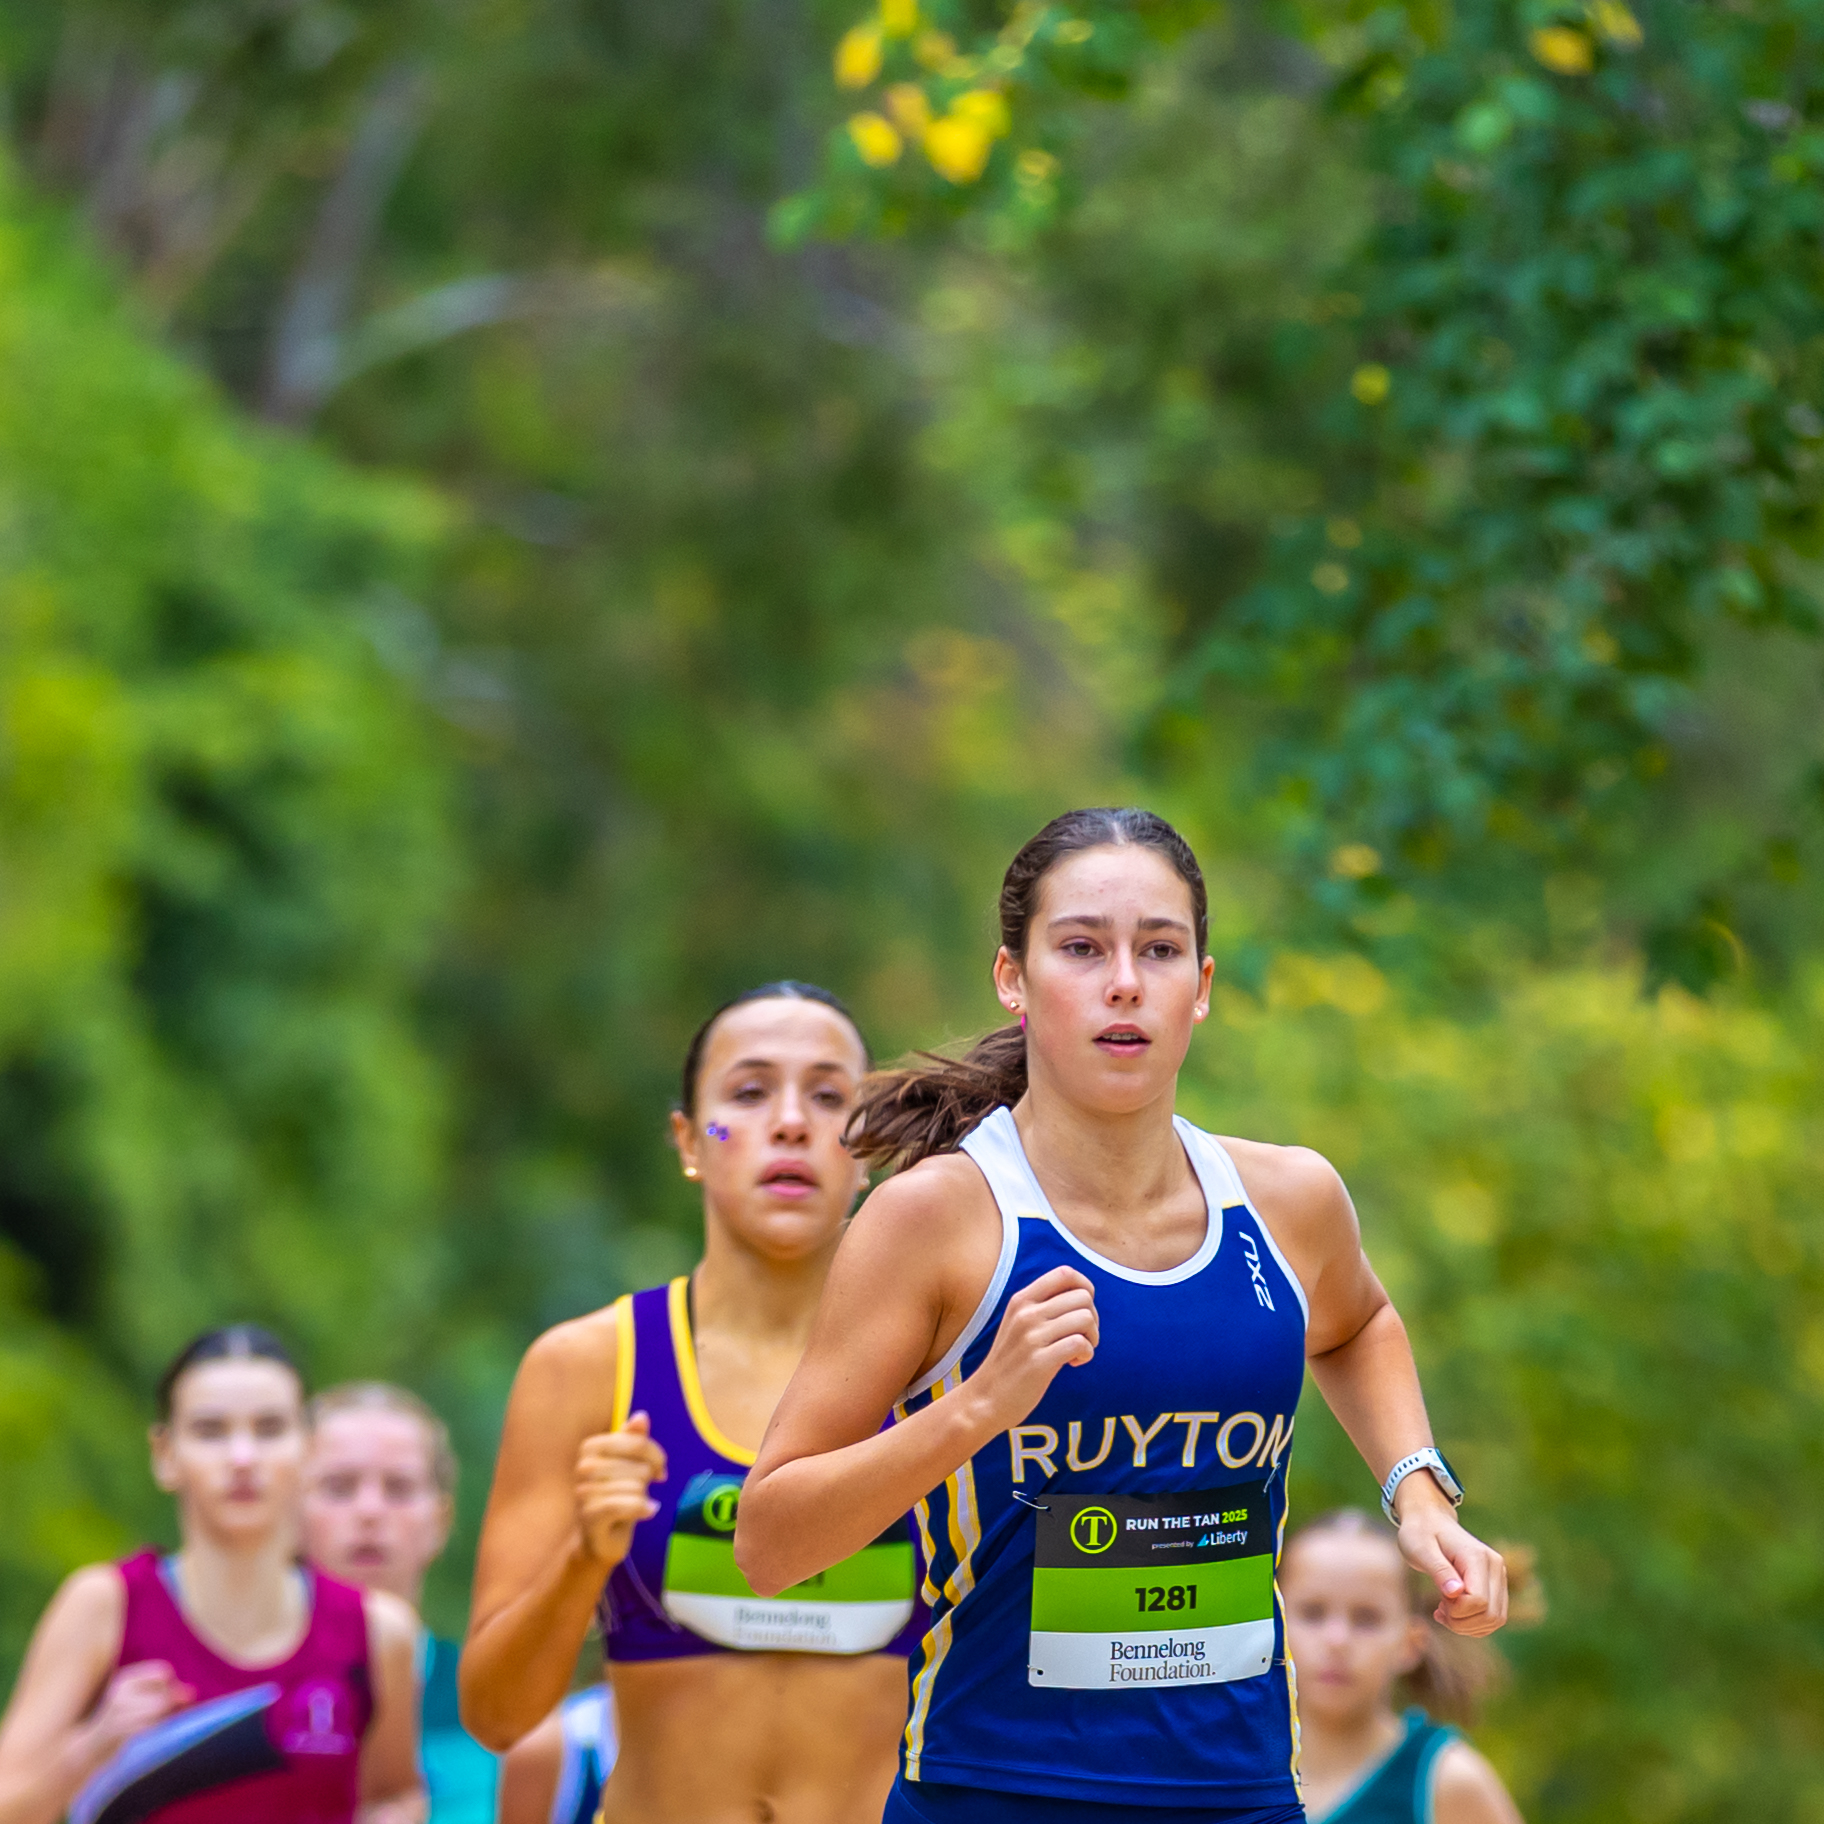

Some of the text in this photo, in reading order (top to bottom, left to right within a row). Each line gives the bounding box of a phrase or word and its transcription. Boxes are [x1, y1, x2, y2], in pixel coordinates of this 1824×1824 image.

[1239, 1231, 1276, 1312] 2XU
[1125, 1508, 1248, 1531] RUN THE TAN 2025
[1186, 1540, 1194, 1548] by
[1210, 1530, 1248, 1546] Liberty
[1134, 1584, 1198, 1613] 1281
[1110, 1637, 1206, 1661] Bennelong
[1109, 1659, 1216, 1682] Foundation.
